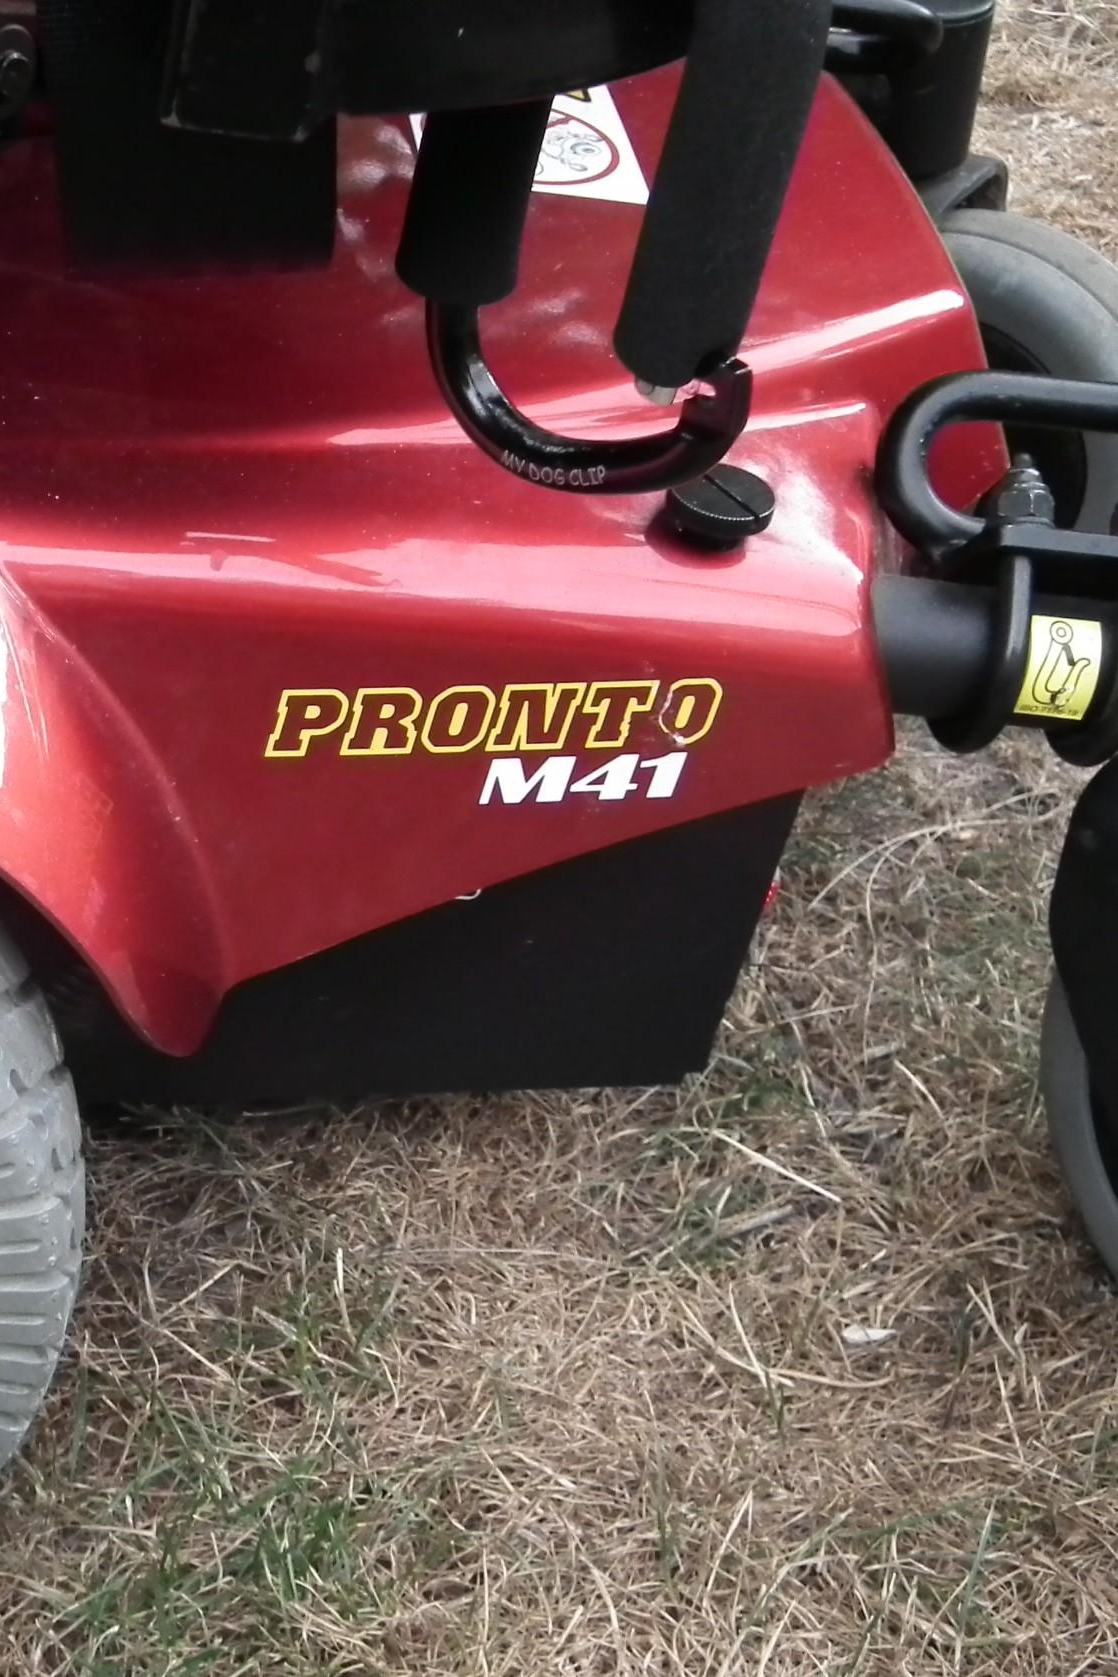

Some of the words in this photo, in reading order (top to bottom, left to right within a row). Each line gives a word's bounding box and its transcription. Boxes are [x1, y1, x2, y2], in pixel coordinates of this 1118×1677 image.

[500, 450, 526, 475] MY
[528, 462, 566, 486] DOG
[569, 465, 607, 487] CLIP
[264, 678, 723, 757] PRONTO
[479, 752, 688, 805] M41
